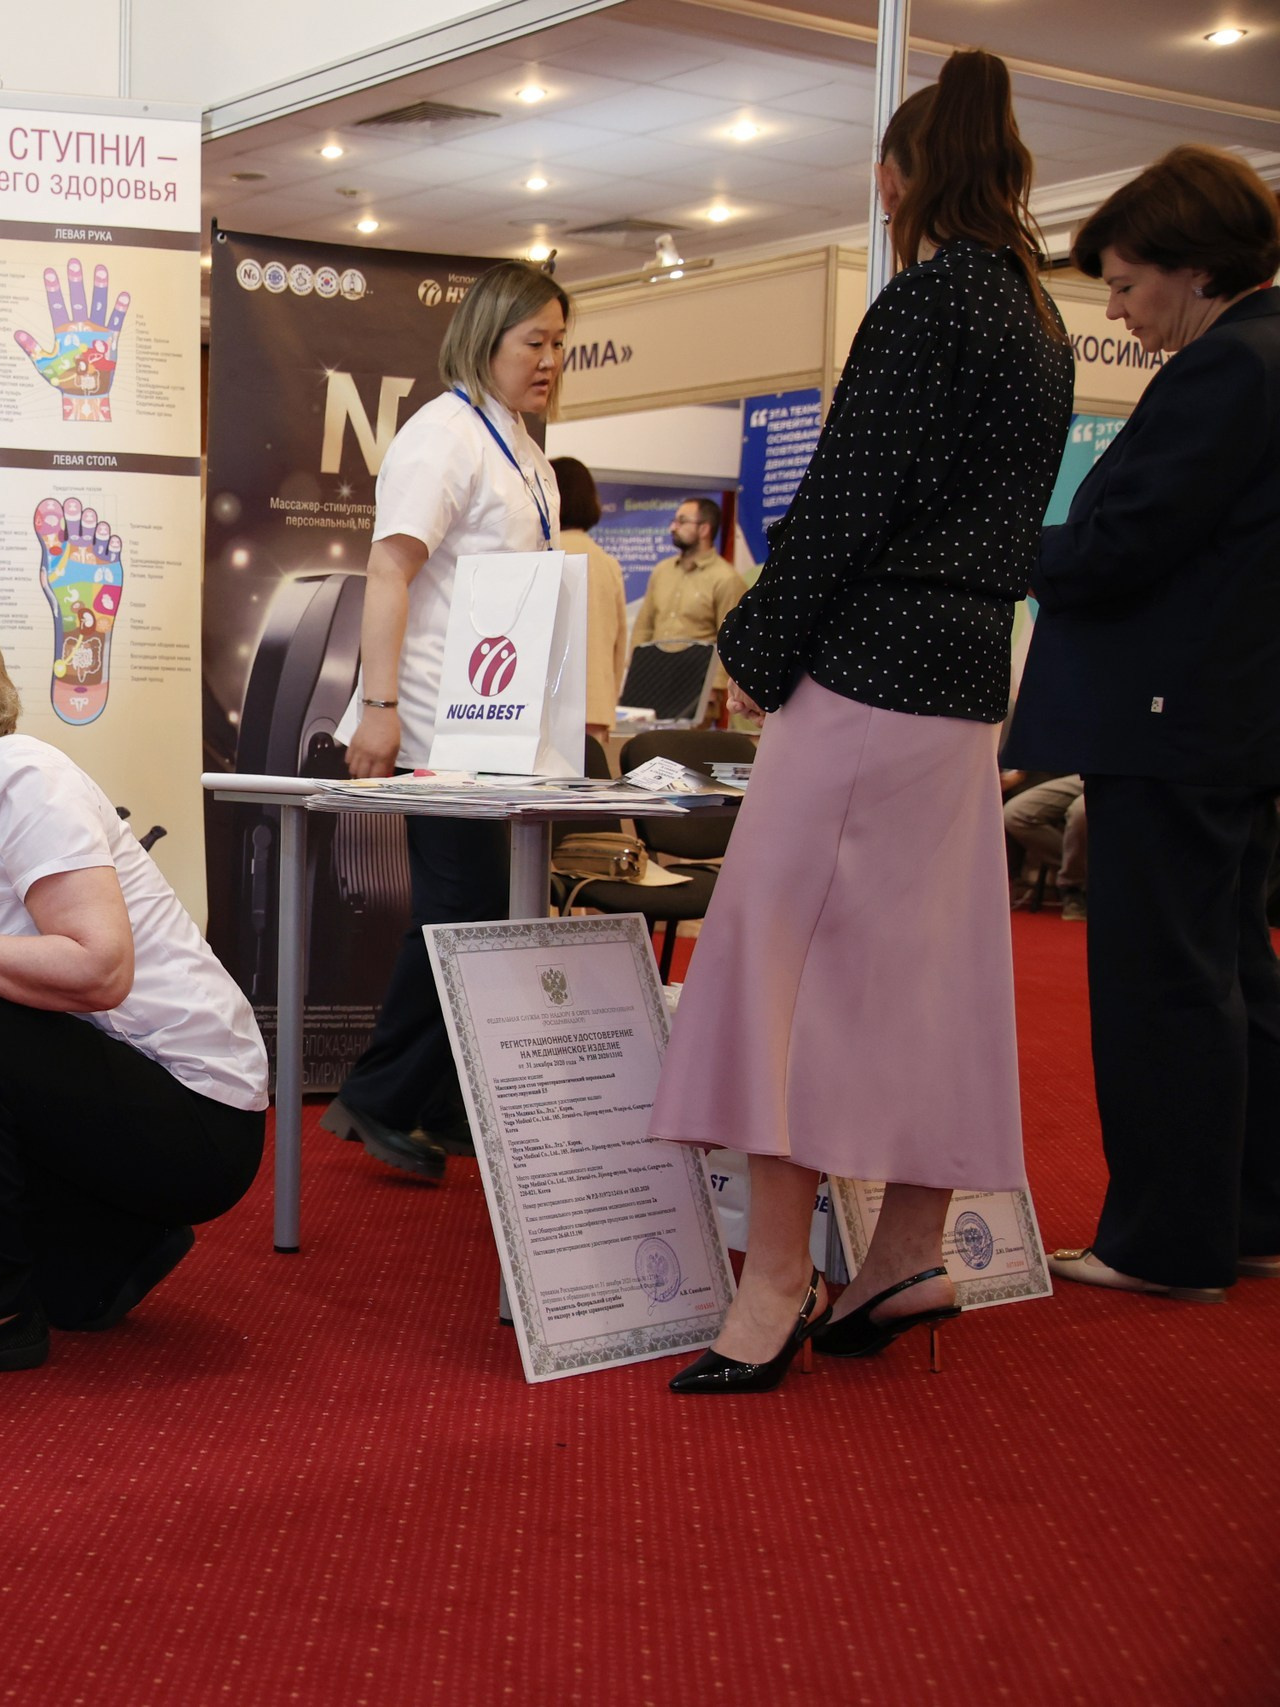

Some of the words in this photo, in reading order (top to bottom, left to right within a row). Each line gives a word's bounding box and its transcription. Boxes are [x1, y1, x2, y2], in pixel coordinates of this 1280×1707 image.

[9, 127, 146, 168] СТУПНИ
[50, 173, 178, 203] здоровья
[55, 228, 85, 240] ЛЕВАЯ
[88, 230, 112, 242] РУКА
[53, 454, 84, 465] ЛЕВАЯ
[87, 455, 117, 467] СТОПА
[270, 497, 376, 516] Массажер-стимулятор
[447, 704, 485, 720] NUGA
[487, 704, 525, 720] BEST
[500, 1034, 573, 1049] РЕГИСТРАЦИОННОЕ
[573, 1029, 634, 1042] УДОСТОВЕРЕНИЕ
[520, 1050, 531, 1059] НА
[532, 1045, 587, 1058] МЕДИЦИНСКОЕ
[588, 1042, 621, 1053] ИЗДЕЛИЕ
